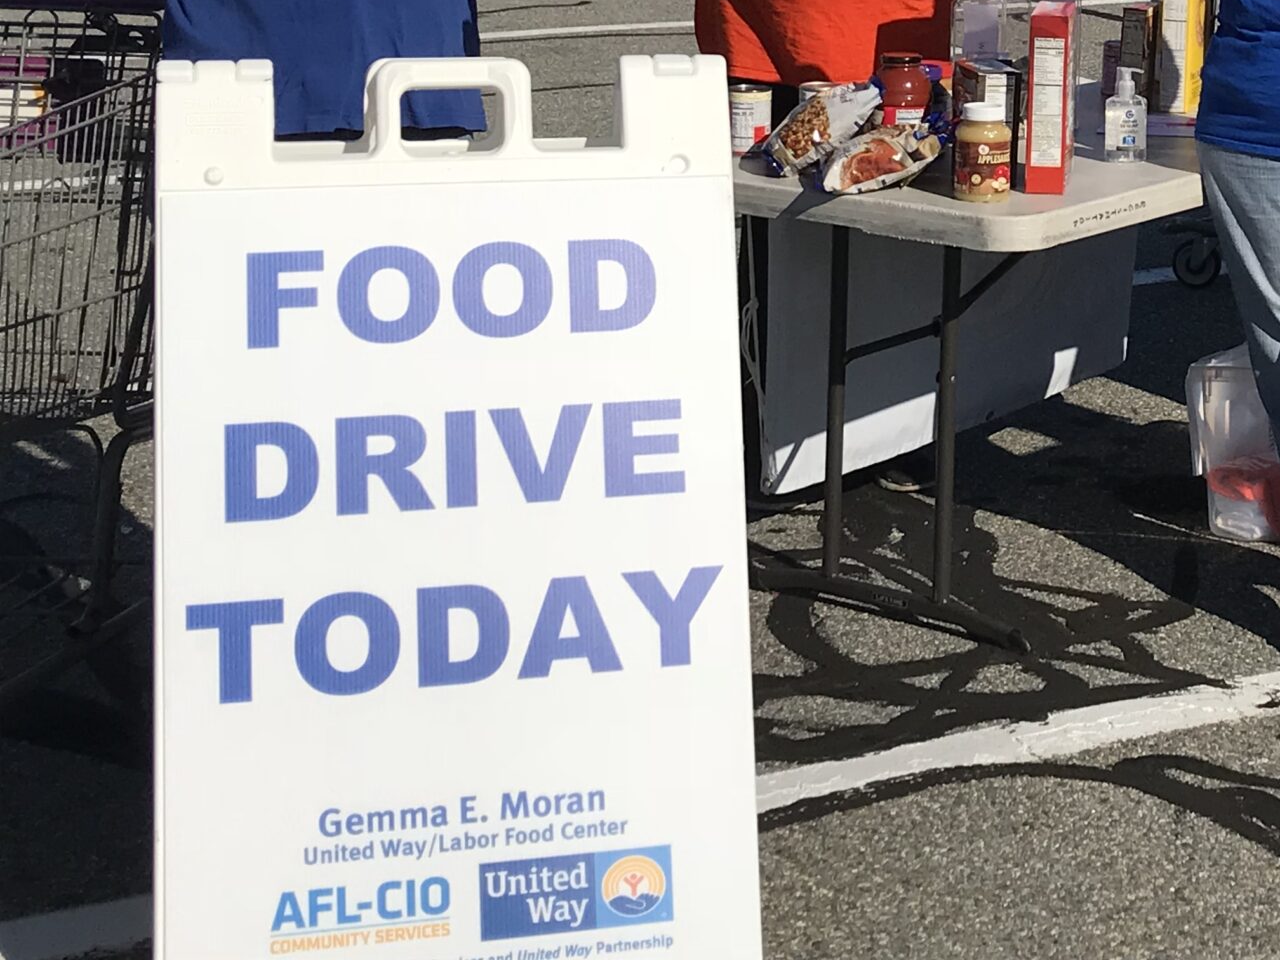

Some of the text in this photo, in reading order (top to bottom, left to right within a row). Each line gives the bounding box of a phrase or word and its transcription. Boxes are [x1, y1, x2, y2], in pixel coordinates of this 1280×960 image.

[246, 238, 657, 350] FOOD
[223, 398, 687, 524] DRIVE
[185, 565, 724, 705] TODAY
[318, 789, 606, 837] Gemma E. Moran
[303, 818, 628, 865] United Way/Labor Food Center
[270, 875, 451, 932] AFL-CIO
[484, 862, 589, 899] United
[526, 896, 590, 928] Way
[270, 922, 451, 956] COMMUNITY SERVICES
[517, 945, 562, 960] United
[565, 944, 593, 959] Way
[596, 935, 674, 955] Partnership
